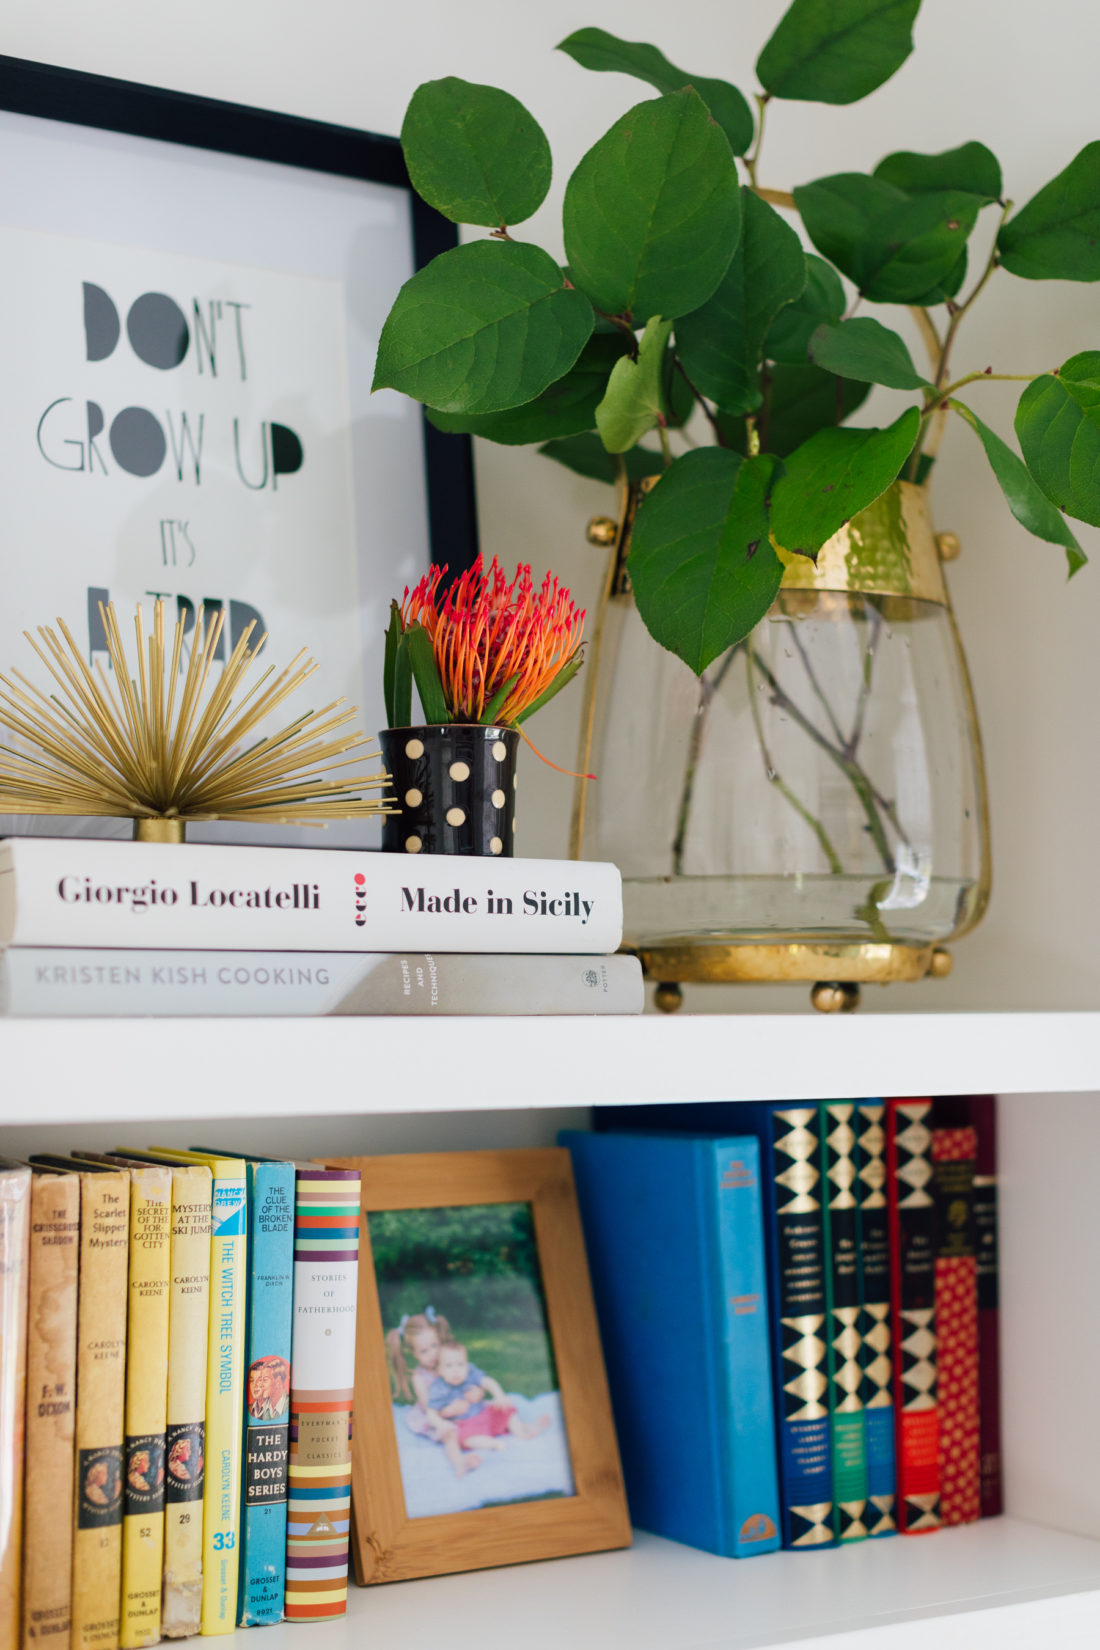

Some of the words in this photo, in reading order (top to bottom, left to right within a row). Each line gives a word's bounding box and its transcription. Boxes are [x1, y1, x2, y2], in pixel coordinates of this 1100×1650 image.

[83, 281, 252, 382] DON'T
[38, 397, 204, 486] GROW
[234, 418, 304, 491] UP
[160, 519, 196, 567] IT'S
[57, 876, 178, 913] Giorgio
[189, 880, 320, 909] Locatelli
[400, 886, 477, 915] Made
[487, 889, 514, 915] in
[522, 890, 594, 925] Sicily
[35, 966, 142, 985] KRISTEN
[152, 967, 207, 985] KISH
[218, 967, 330, 986] COOKING
[400, 959, 411, 996] RECIPES
[416, 967, 424, 988] AND
[215, 1187, 245, 1198] NANCY
[269, 1187, 285, 1195] THE
[102, 1193, 119, 1204] The
[215, 1197, 242, 1207] DREW
[265, 1196, 287, 1205] CLUE
[93, 1208, 127, 1219] Scarlet
[137, 1207, 168, 1216] SECRET
[172, 1204, 211, 1213] MYSTERY
[261, 1206, 274, 1214] OF
[275, 1205, 290, 1213] THE
[137, 1216, 149, 1224] OF
[152, 1215, 168, 1223] THE
[177, 1215, 190, 1224] AT
[192, 1214, 209, 1223] THE
[259, 1214, 293, 1223] BROKEN
[93, 1222, 127, 1235] Slipper
[172, 1226, 188, 1235] SKI
[189, 1225, 212, 1236] JUMP
[261, 1223, 289, 1232] BLADE
[134, 1232, 169, 1240] GOTTEN
[89, 1237, 128, 1249] Mystery
[142, 1240, 163, 1249] CITY
[221, 1241, 234, 1263] THE
[132, 1280, 168, 1289] CAROLYN
[174, 1275, 208, 1284] CAROLYN
[139, 1288, 162, 1297] KEENE
[181, 1286, 202, 1294] KEENE
[220, 1267, 233, 1307] WITCH
[323, 1290, 335, 1298] OF
[298, 1305, 356, 1313] FATHERHOOD
[220, 1311, 233, 1341] TREE
[219, 1344, 232, 1395] SYMBOL
[38, 1401, 70, 1417] DIXON
[172, 1425, 193, 1438] NANCY
[257, 1434, 281, 1446] THE
[311, 1435, 339, 1443] POCKET
[248, 1450, 288, 1463] HARDY
[221, 1449, 231, 1491] CAROLYN
[254, 1467, 283, 1480] BOYS
[248, 1482, 286, 1497] SERIES
[221, 1493, 230, 1521] KEENE
[179, 1513, 190, 1524] 29
[140, 1527, 151, 1537] 52
[213, 1531, 235, 1551] 33
[250, 1575, 280, 1586] GROSSET
[127, 1589, 160, 1600] GROSSET
[250, 1593, 279, 1603] DUNLAP
